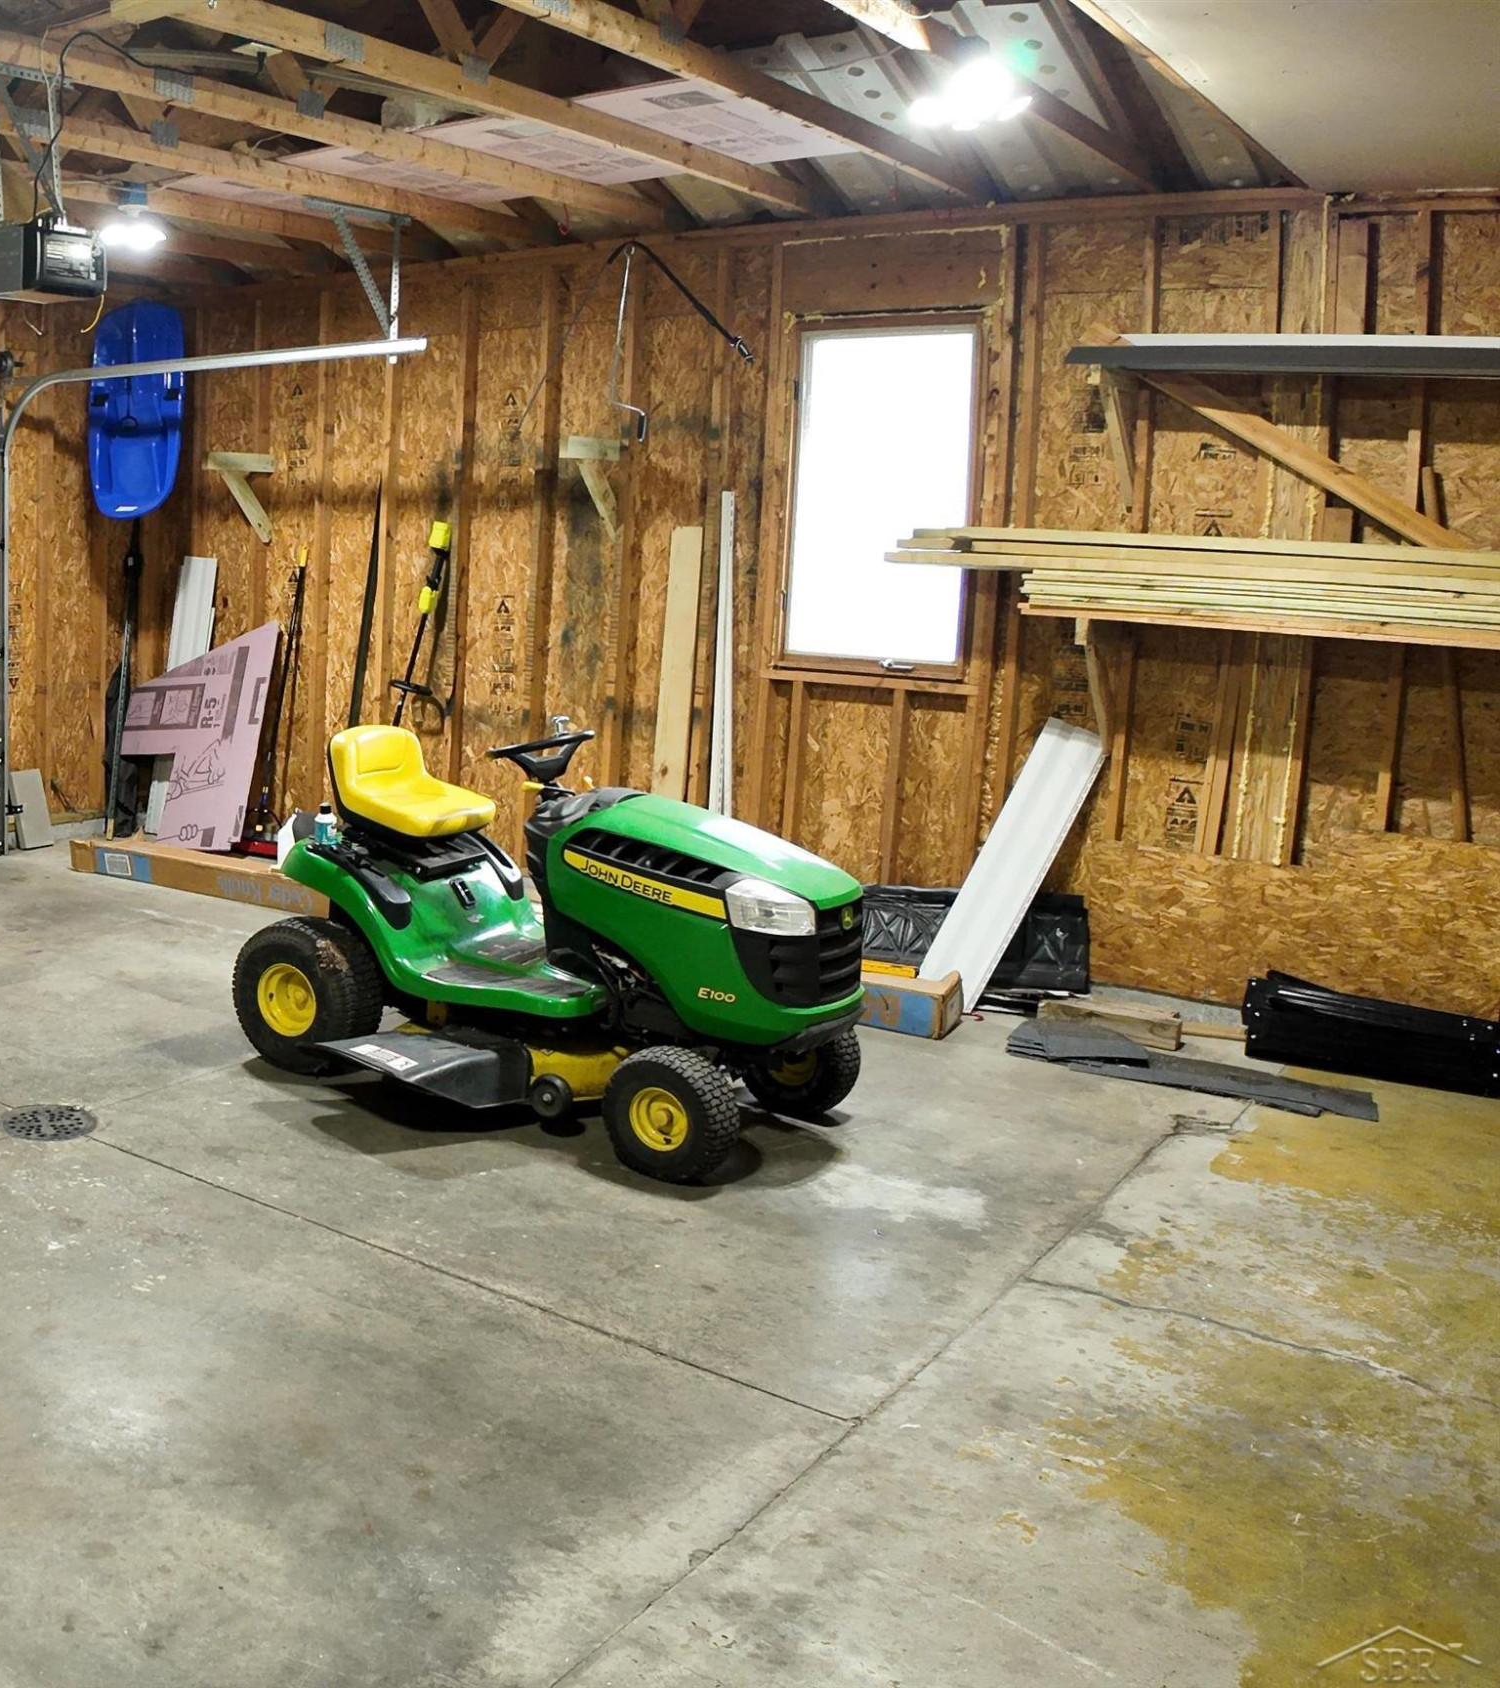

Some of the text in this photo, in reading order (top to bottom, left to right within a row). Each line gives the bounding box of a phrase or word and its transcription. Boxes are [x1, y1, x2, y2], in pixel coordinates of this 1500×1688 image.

[200, 697, 218, 729] R-5
[580, 859, 673, 902] JOHN DEERE
[697, 986, 736, 1003] E100
